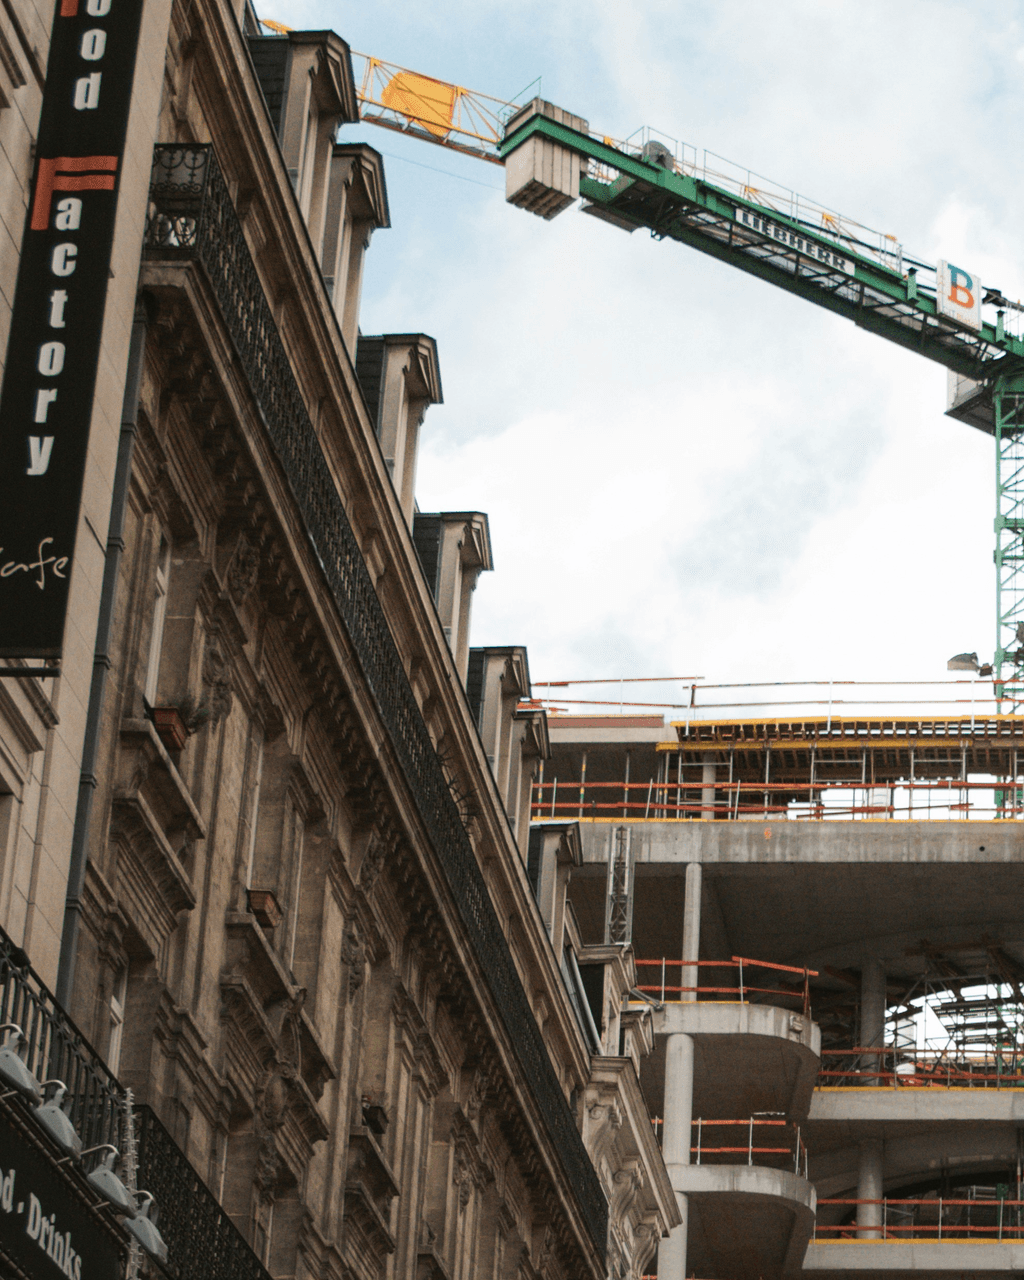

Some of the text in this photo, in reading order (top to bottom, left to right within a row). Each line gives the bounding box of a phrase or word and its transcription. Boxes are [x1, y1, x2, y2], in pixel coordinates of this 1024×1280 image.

[742, 213, 846, 271] LIEBHERR
[947, 263, 975, 309] B
[26, 155, 119, 476] Factory
[0, 537, 69, 590] afe
